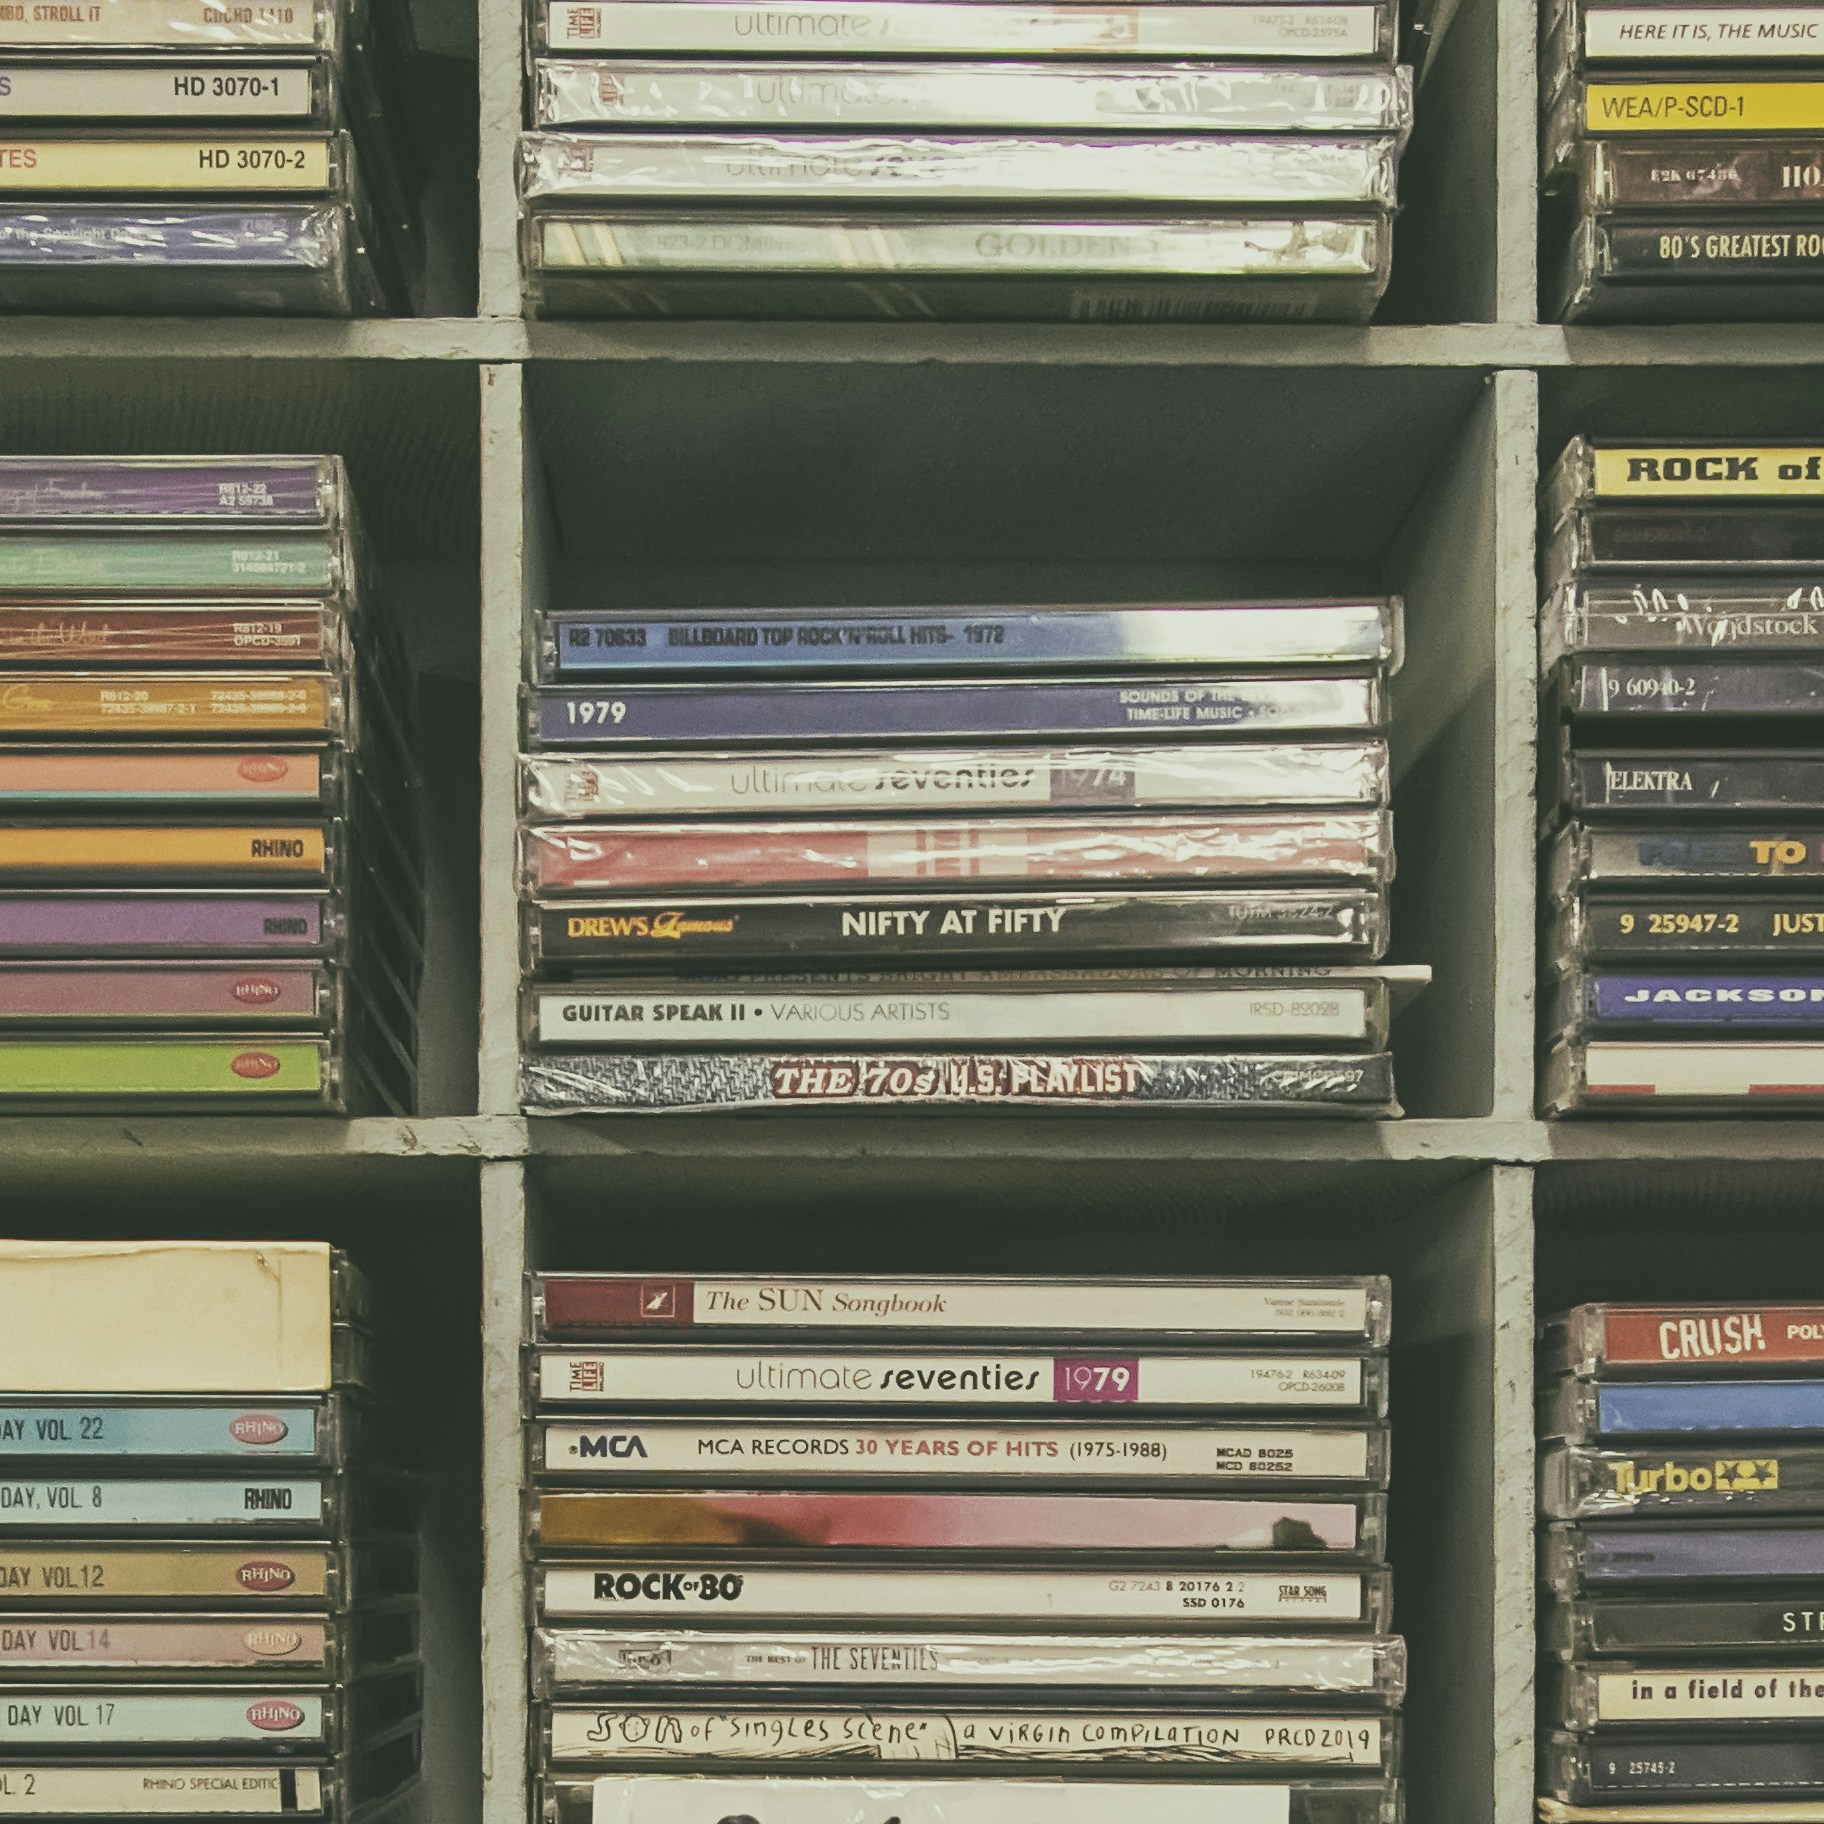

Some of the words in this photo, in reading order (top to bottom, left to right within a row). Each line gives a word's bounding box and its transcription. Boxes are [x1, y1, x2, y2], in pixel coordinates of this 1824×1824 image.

[174, 76, 204, 97] HD
[212, 76, 279, 97] 3070-1
[1602, 95, 1745, 119] WEA/P-SCD-1
[1627, 456, 1759, 482] ROCK
[1778, 455, 1822, 481] of
[566, 701, 627, 724] 1979
[251, 839, 304, 859] RHINO
[841, 910, 930, 937] NIFTY
[940, 909, 977, 935] AT
[988, 907, 1066, 934] FIFTY
[562, 1004, 644, 1022] GUITAR
[653, 1003, 721, 1022] SPEAK
[730, 1003, 745, 1021] II
[769, 1001, 864, 1022] VARIOUS
[871, 1000, 951, 1021] ARTISTS
[707, 1290, 750, 1311] The
[758, 1286, 822, 1311] SUN
[832, 1291, 947, 1317] Songbook
[1658, 1314, 1767, 1361] CRUSH
[736, 1362, 872, 1391] ultimate
[880, 1362, 1040, 1391] seventies
[1064, 1365, 1131, 1393] 1979
[1632, 1678, 1652, 1700] in
[1664, 1685, 1677, 1700] a
[1688, 1677, 1743, 1700] field
[1754, 1677, 1778, 1699] of
[24, 1772, 36, 1796] 2
